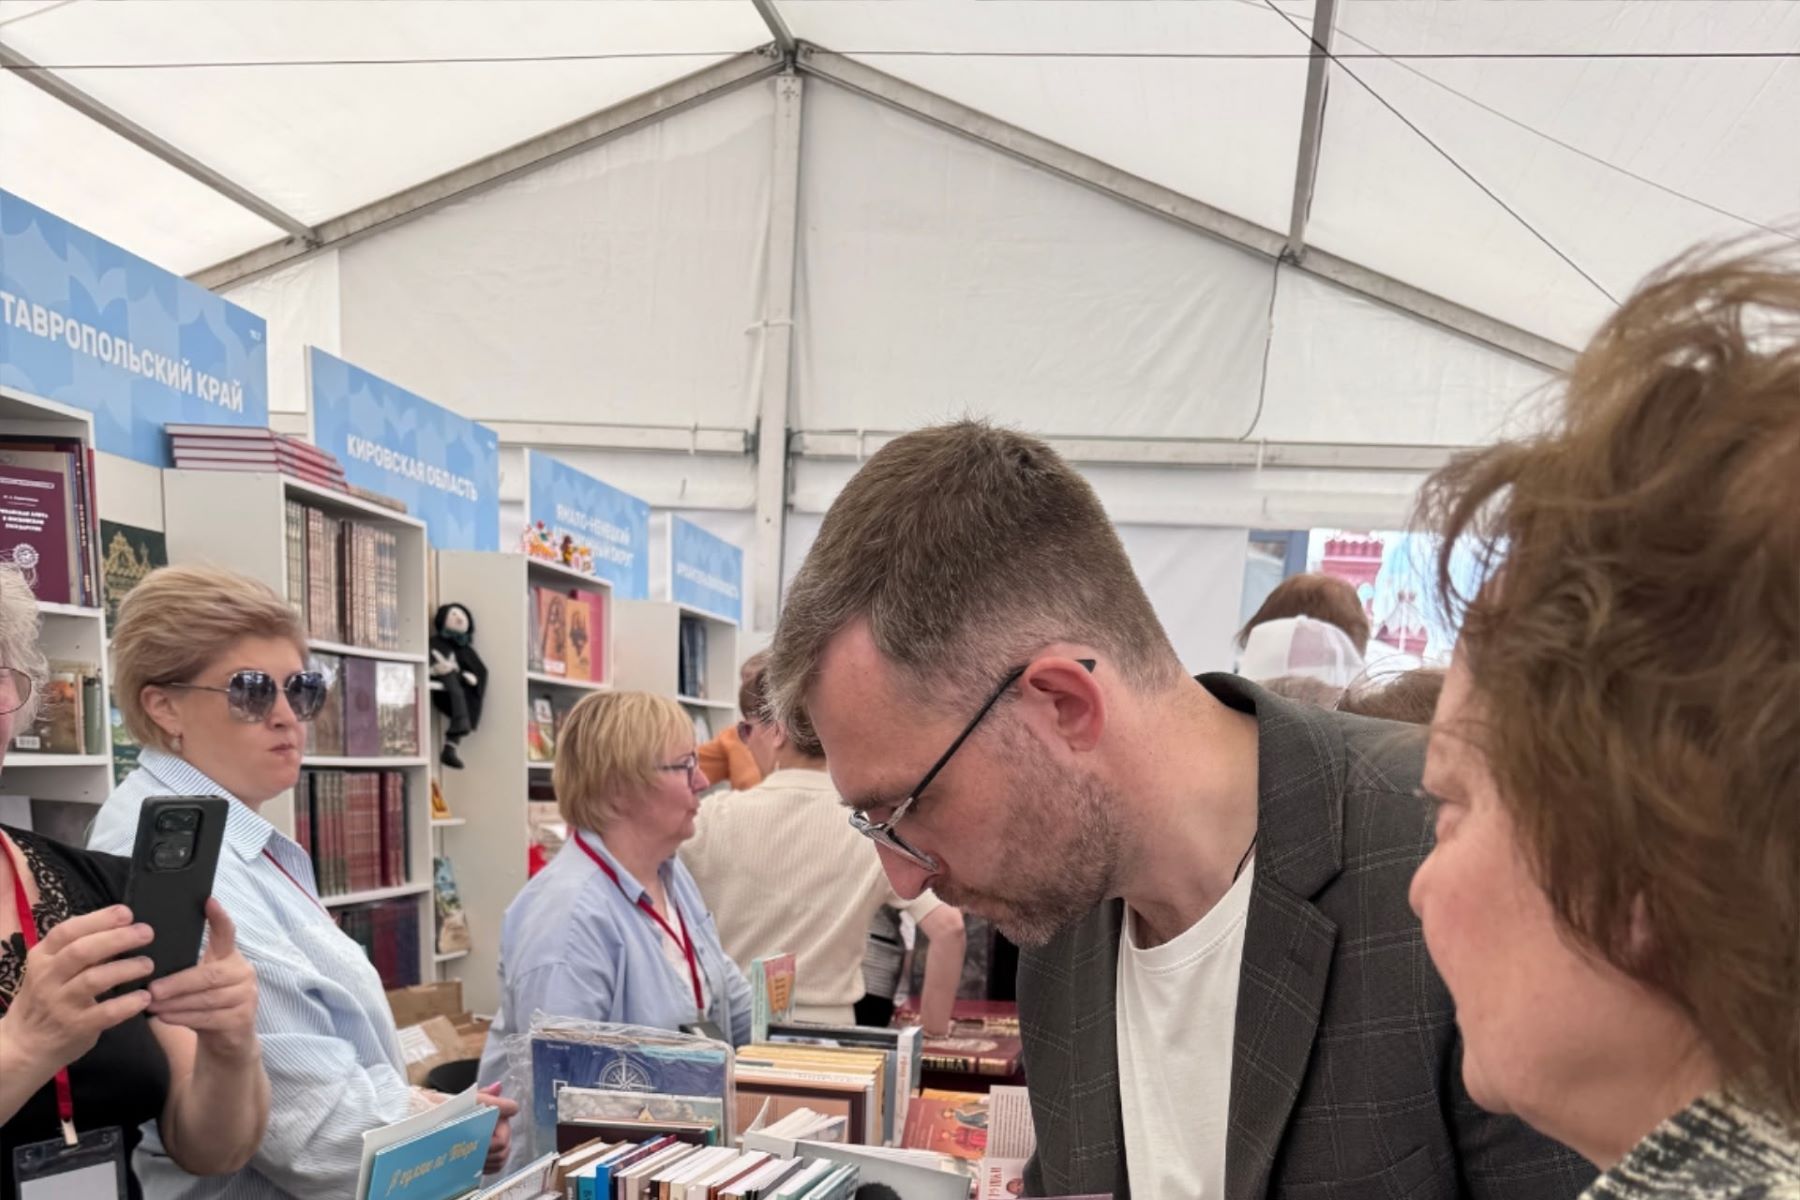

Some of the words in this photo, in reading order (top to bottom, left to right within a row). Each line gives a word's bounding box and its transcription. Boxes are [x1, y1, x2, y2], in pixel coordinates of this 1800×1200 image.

[0, 291, 193, 395] ТАВРОПОЛЬСКИЙ
[197, 371, 243, 414] КРАЙ
[347, 433, 425, 483] КИРОВСКАЯ
[427, 463, 478, 502] ОБЛАСТЬ
